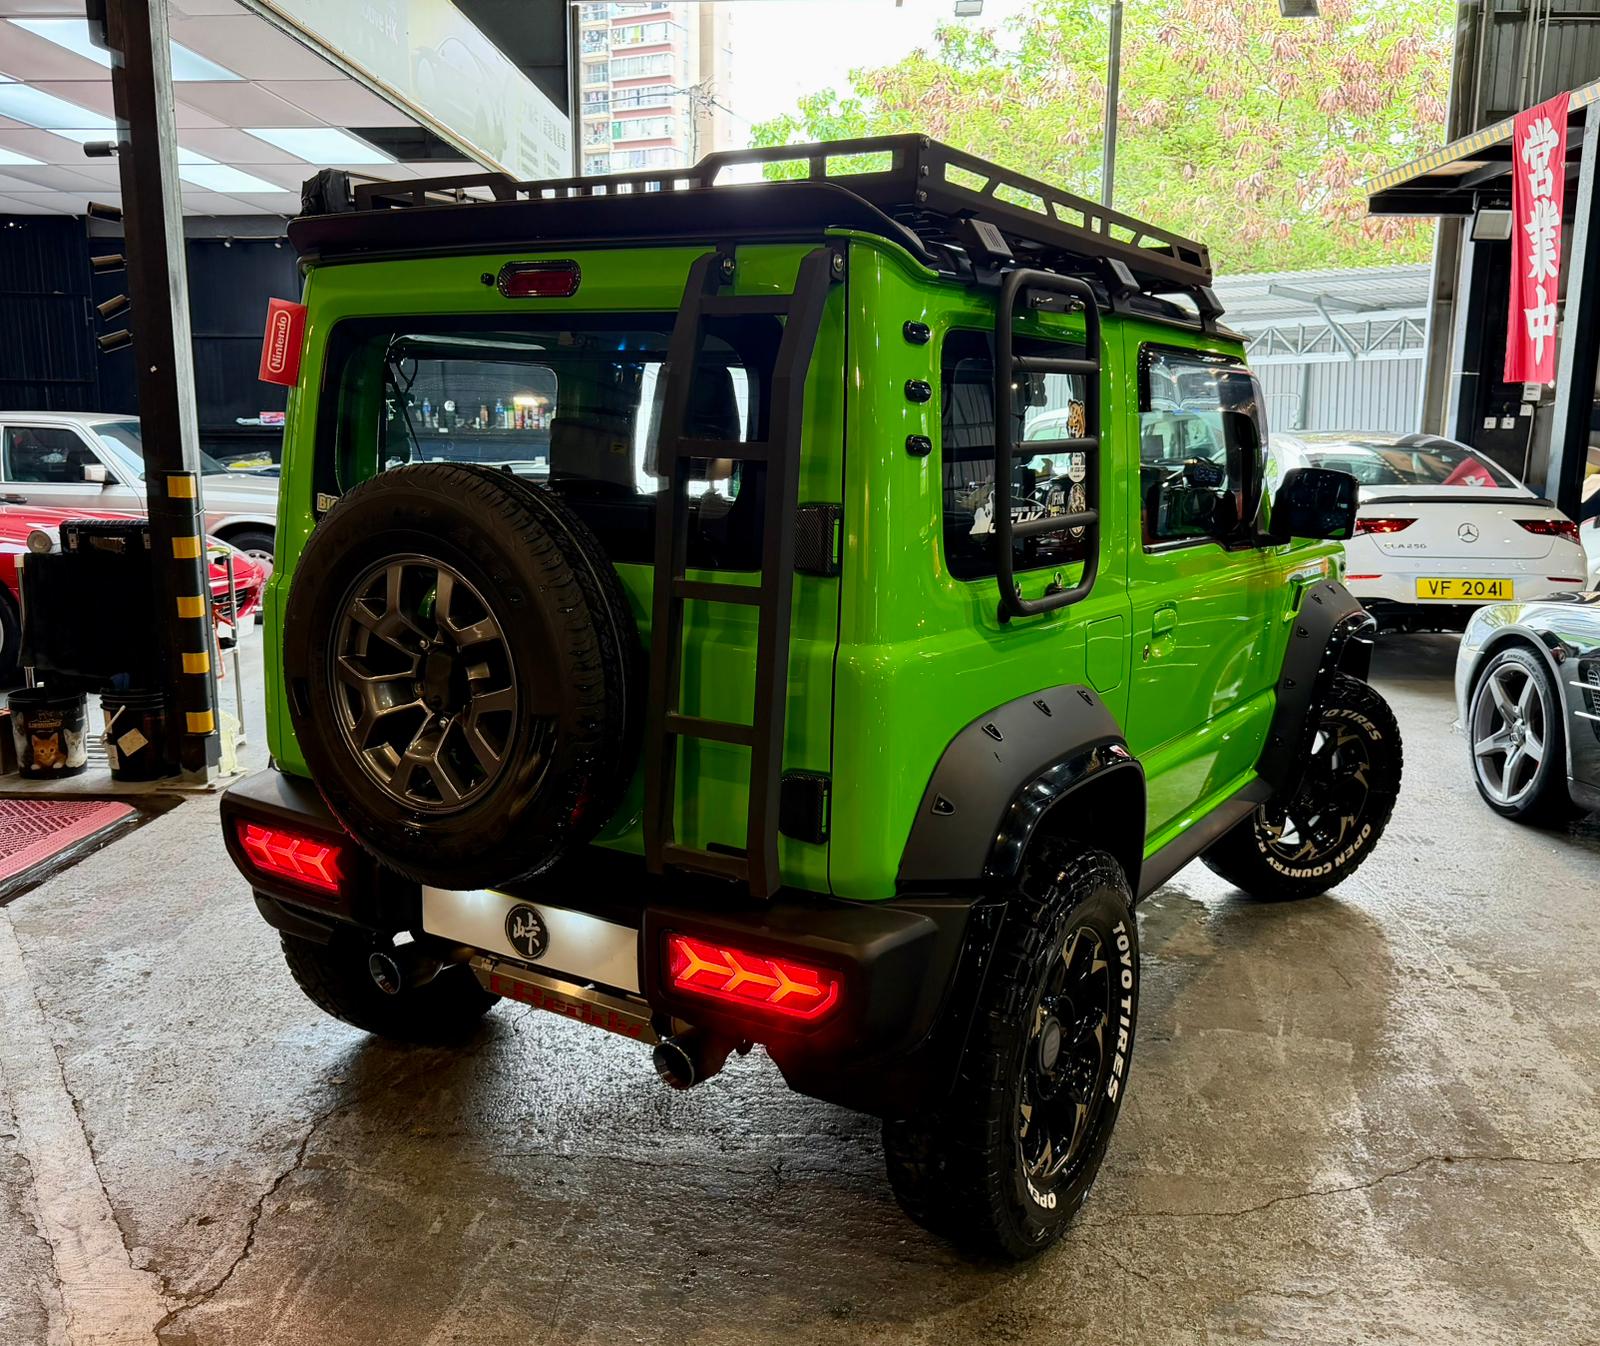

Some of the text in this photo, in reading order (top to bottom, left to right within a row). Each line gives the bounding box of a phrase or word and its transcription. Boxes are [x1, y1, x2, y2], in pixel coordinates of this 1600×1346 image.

[271, 316, 288, 368] Nintendo
[1428, 580, 1502, 597] VF 2041
[1340, 709, 1383, 741] TIRES
[1266, 856, 1333, 878] COUNTRY
[1334, 823, 1372, 868] OPEN
[513, 912, 541, 955] 峠
[1107, 921, 1133, 1104] TOYO TIRES
